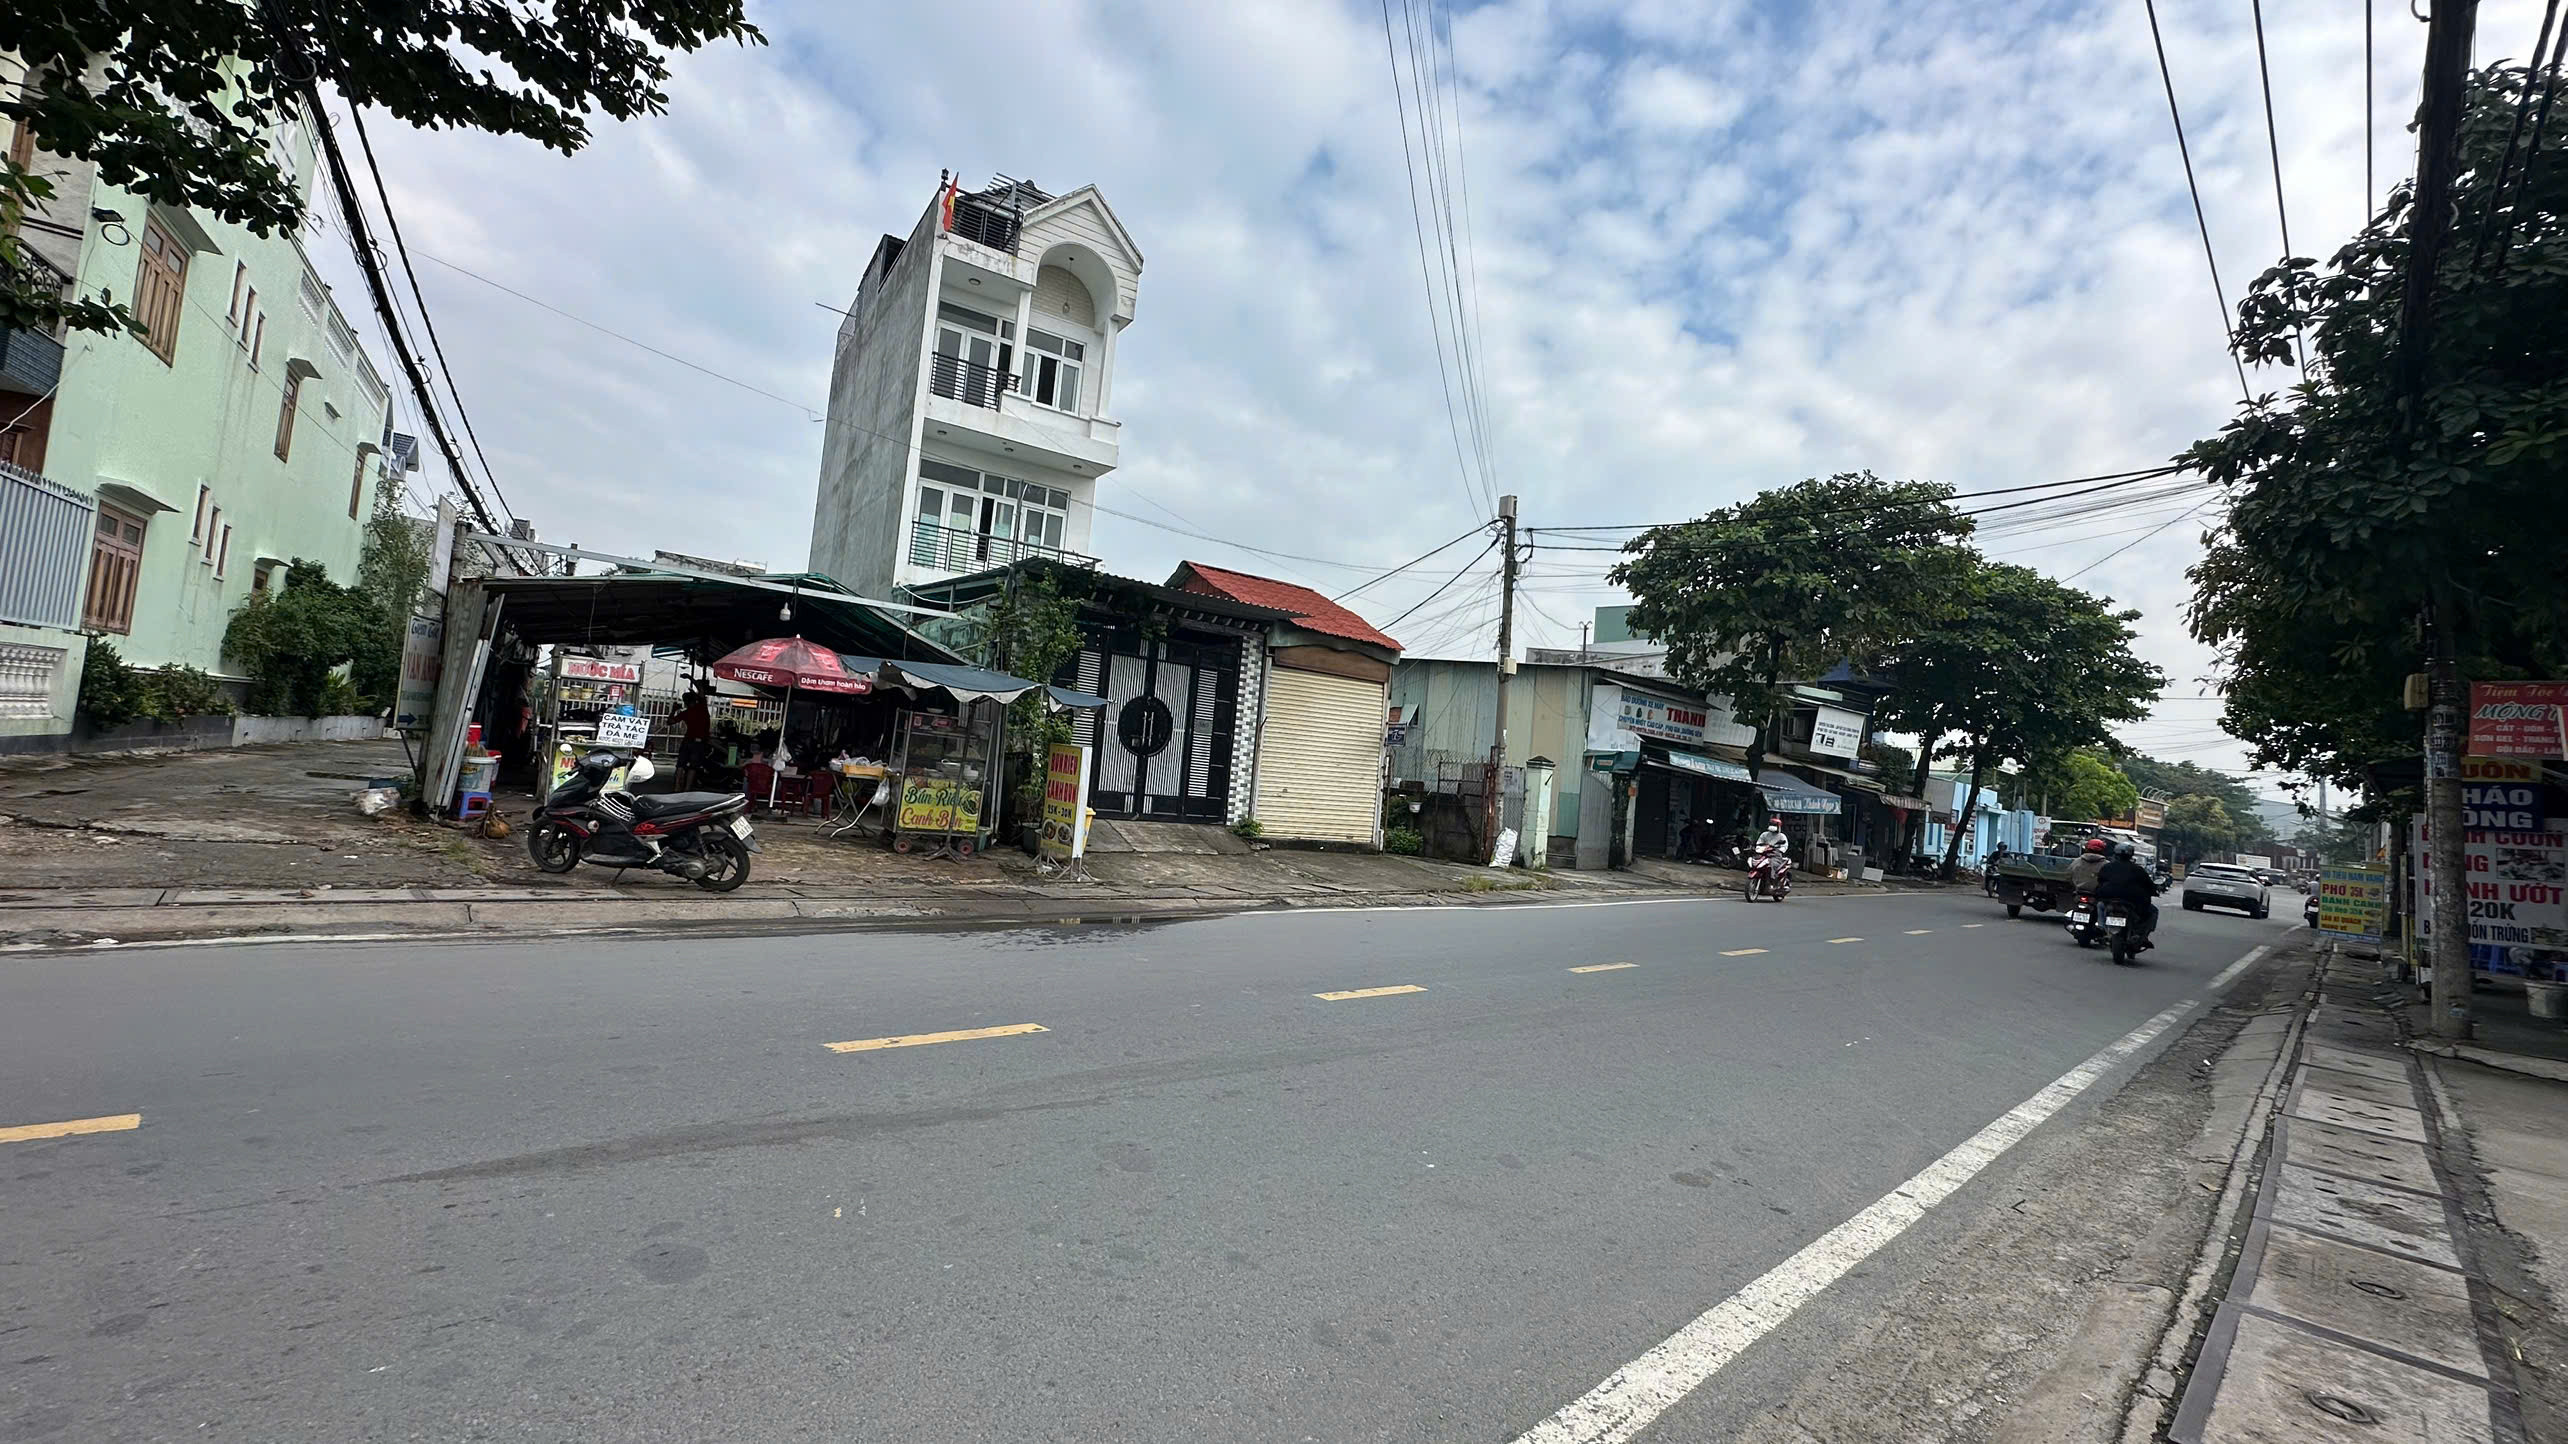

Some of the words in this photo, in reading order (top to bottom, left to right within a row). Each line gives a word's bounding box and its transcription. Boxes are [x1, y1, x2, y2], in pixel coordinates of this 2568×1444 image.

[2462, 785, 2533, 806] HÁO
[2463, 806, 2533, 829] ÒNG
[2470, 901, 2516, 921] 20K
